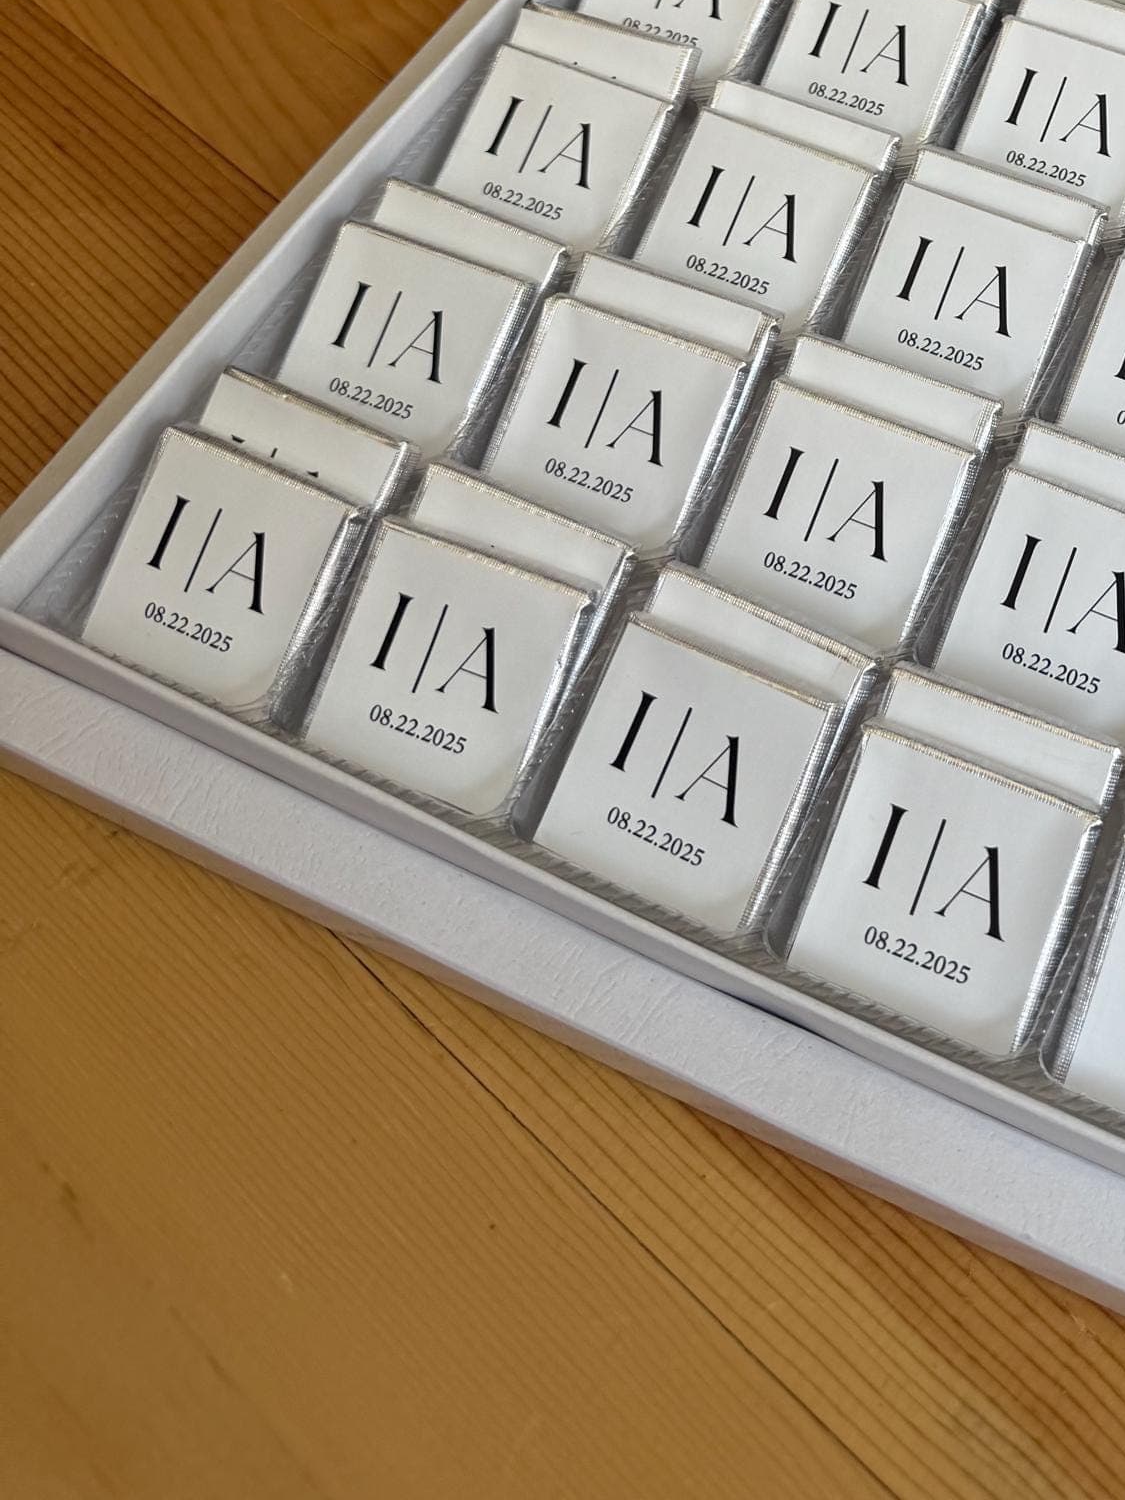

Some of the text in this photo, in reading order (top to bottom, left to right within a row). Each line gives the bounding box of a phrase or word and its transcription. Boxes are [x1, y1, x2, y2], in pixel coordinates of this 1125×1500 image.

[809, 82, 884, 115] 08.22.2025
[1005, 150, 1087, 187] 08.22.2025
[483, 182, 563, 220] 08.22.2025
[687, 255, 769, 294] 08.22.2025
[898, 329, 984, 370] 08.22.2025
[329, 378, 413, 419] 08.22.2025
[545, 458, 633, 502] 08.22.2025
[764, 552, 857, 599] 08.22.2025
[145, 602, 232, 652] 08.22.2025
[1003, 643, 1100, 693] 08.22.2025
[370, 705, 466, 753] 08.22.2025
[608, 807, 704, 865] 08.22.2025
[865, 926, 970, 983] 08.22.2025
